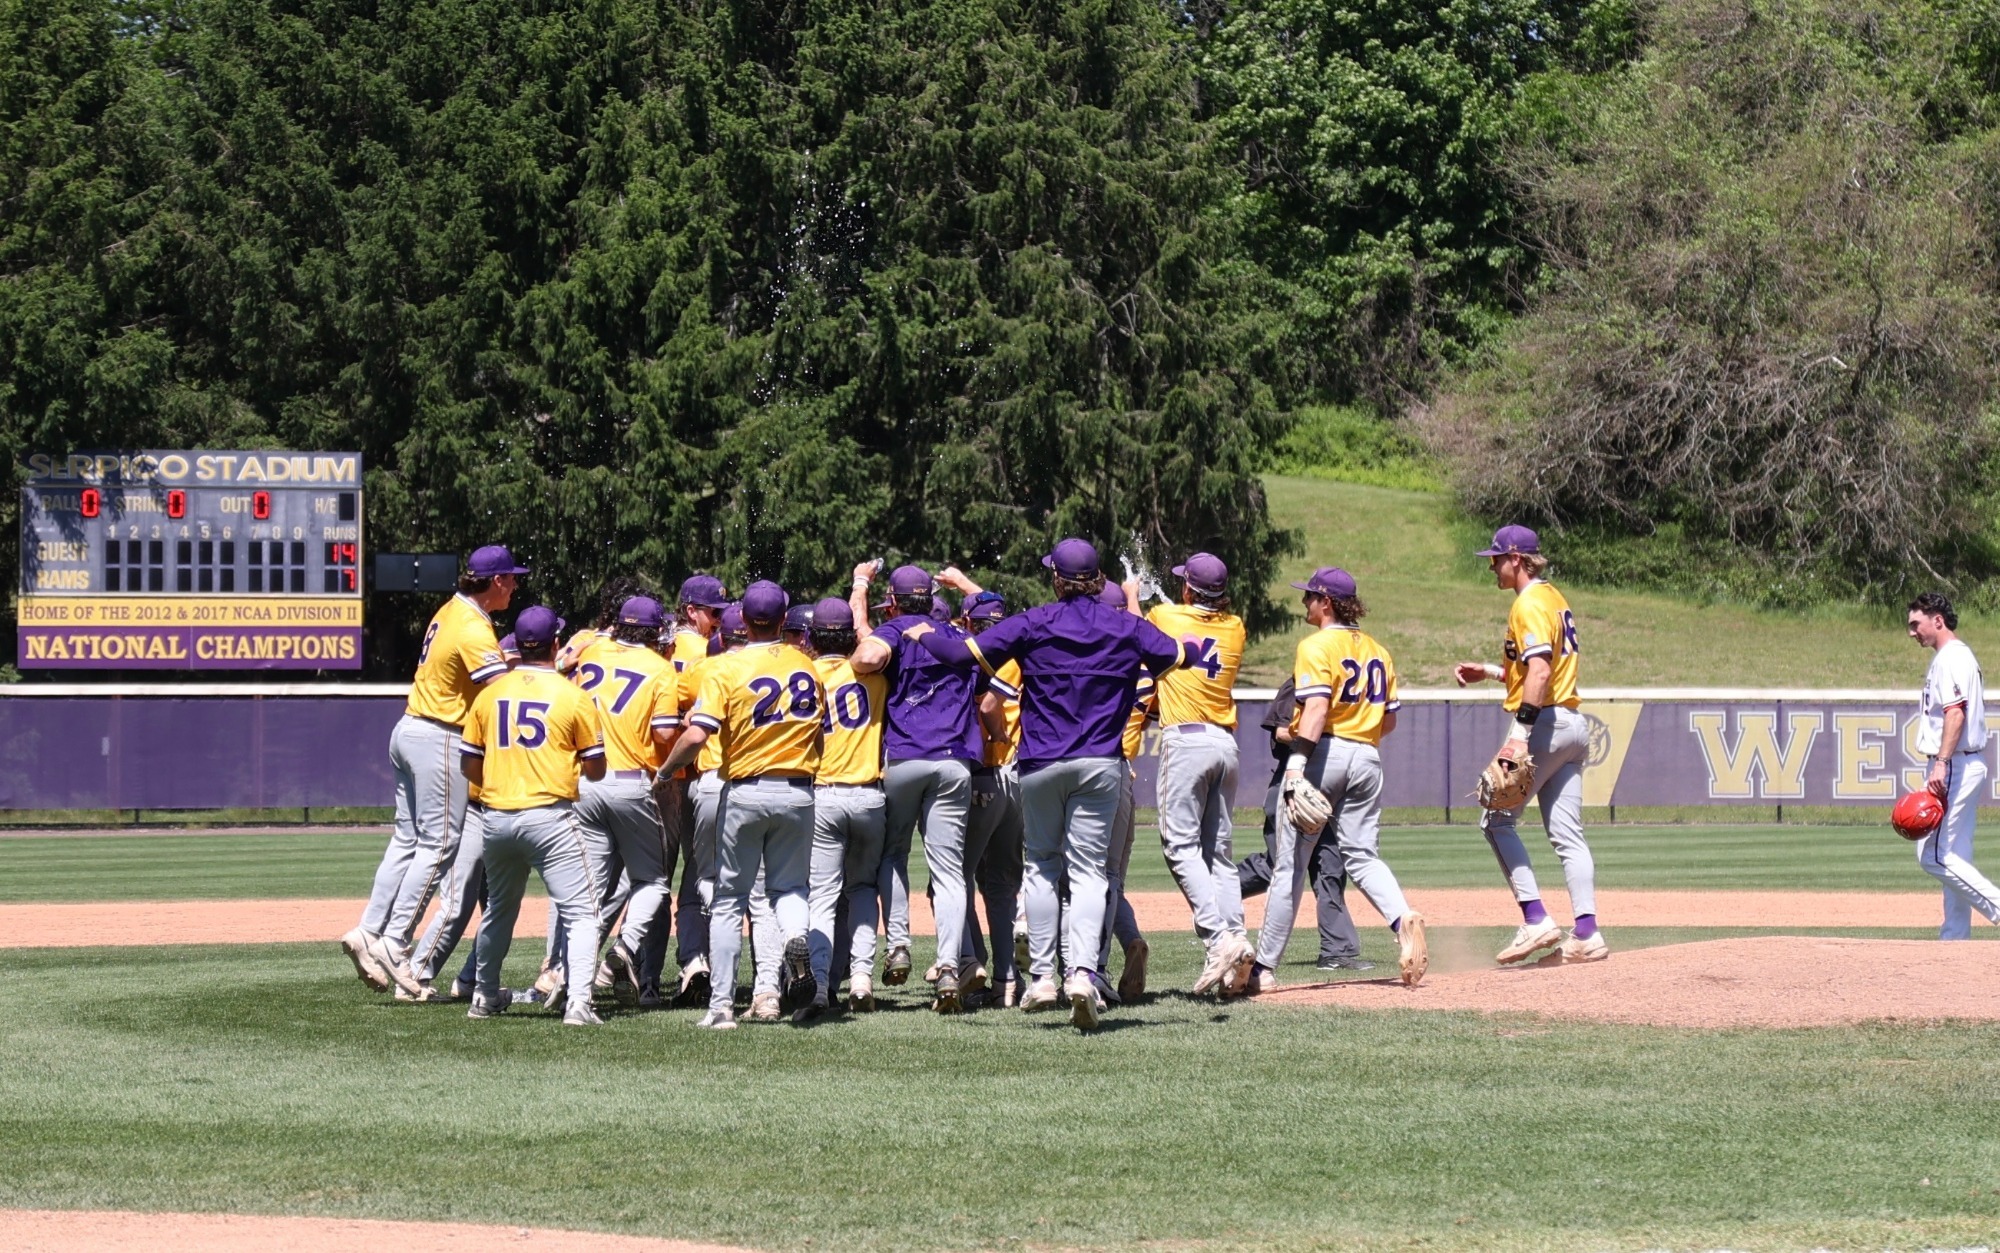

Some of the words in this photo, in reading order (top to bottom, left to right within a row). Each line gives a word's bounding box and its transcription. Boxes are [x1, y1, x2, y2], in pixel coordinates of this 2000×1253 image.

[29, 454, 189, 480] SERPICO
[196, 456, 356, 482] STADIUM
[81, 489, 100, 518] 0
[168, 490, 185, 519] 0
[220, 497, 251, 513] OUT
[253, 491, 270, 519] 0
[315, 497, 337, 514] H/E
[108, 525, 116, 539] 1
[129, 525, 139, 539] 2
[151, 525, 160, 539] 3
[179, 525, 189, 539] 4
[200, 525, 210, 539] 5
[222, 525, 231, 539] 6
[251, 525, 260, 539] 7
[272, 525, 281, 539] 8
[293, 525, 302, 539] 9
[323, 526, 357, 540] RUNS
[37, 541, 88, 562] GUEST
[332, 543, 356, 564] 14
[37, 570, 90, 590] RAMS
[343, 569, 356, 590] 7
[23, 606, 68, 620] HOME
[74, 606, 94, 620] OF
[100, 606, 130, 620] THE
[136, 606, 171, 620] 2012
[176, 606, 187, 620] &
[193, 606, 228, 620] 2017
[233, 606, 272, 620] NCAA
[277, 606, 342, 620] DIVISION
[347, 606, 357, 620] II
[25, 635, 187, 660] NATIONAL
[196, 635, 356, 660] CHAMPIONS
[579, 662, 648, 715] 27
[1340, 656, 1388, 705] 20
[747, 670, 821, 728] 28
[496, 699, 551, 750] 15
[1689, 710, 2000, 801] WE
